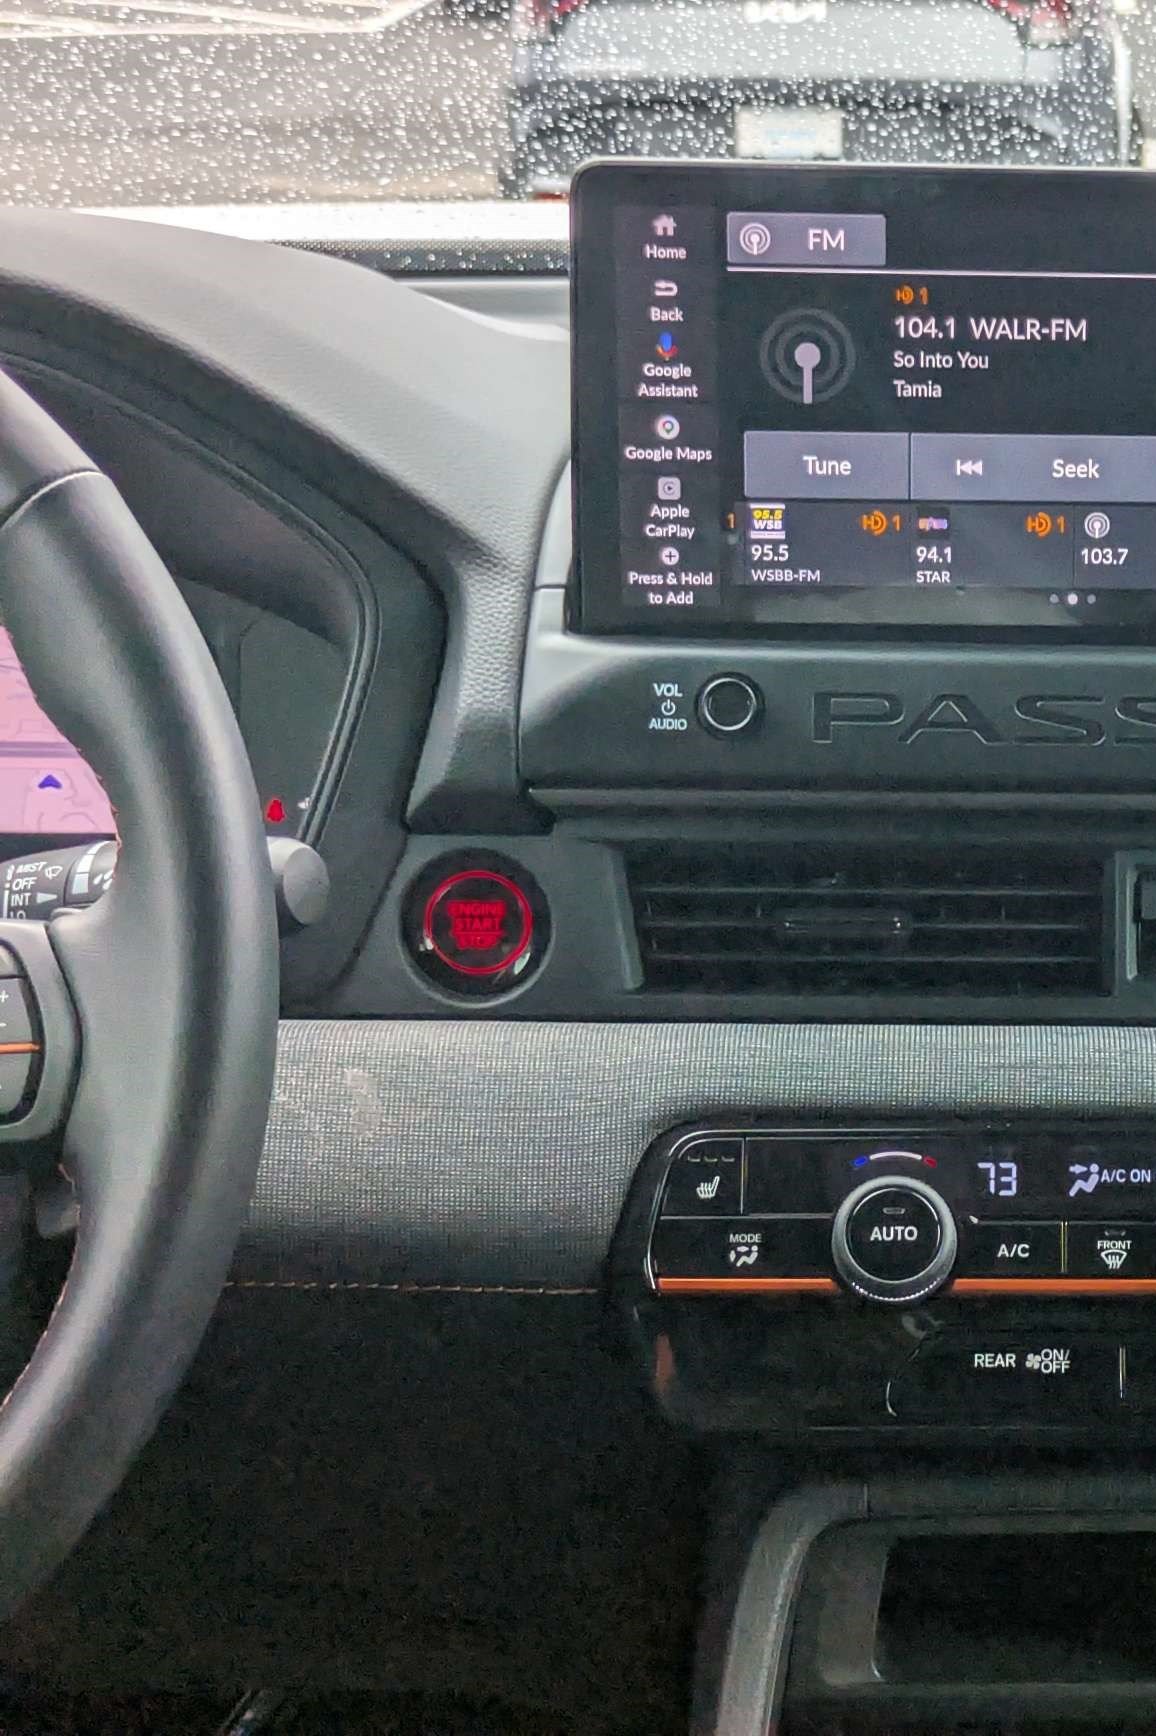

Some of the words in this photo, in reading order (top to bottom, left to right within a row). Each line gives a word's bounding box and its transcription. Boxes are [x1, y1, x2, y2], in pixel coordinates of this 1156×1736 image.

[808, 229, 845, 251] FM
[645, 244, 687, 260] Home
[650, 307, 684, 322] Back
[894, 316, 957, 339] 104.1
[970, 317, 1088, 341] WALR-FM
[893, 351, 915, 368] So
[920, 350, 953, 369] Into
[956, 352, 989, 370] You
[643, 364, 692, 379] Google
[638, 383, 699, 398] Assistant
[893, 380, 942, 399] Tamia
[625, 446, 674, 462] Google
[676, 447, 713, 463] Maps
[803, 456, 852, 476] Tune
[1052, 459, 1100, 479] Seek
[650, 504, 690, 520] Apple
[752, 509, 784, 520] 95.5
[753, 520, 783, 530] WSB
[892, 514, 901, 532] 1
[1056, 516, 1065, 534] 1
[645, 524, 696, 540] CarPlay
[751, 544, 789, 562] 95.5
[915, 546, 952, 563] 94.1
[1081, 547, 1129, 565] 103.7
[629, 571, 664, 586] Press
[666, 572, 677, 586] &
[679, 571, 713, 586] Hold
[751, 569, 821, 582] WSBB-FM
[916, 570, 951, 583] STAR
[649, 591, 663, 604] to
[666, 591, 694, 605] Add
[653, 683, 683, 698] VOL
[648, 717, 688, 731] AUDIO
[12, 877, 37, 891] OFF
[11, 893, 32, 906] INT
[454, 918, 500, 931] START
[977, 1162, 1017, 1196] 73
[1101, 1168, 1126, 1183] A/C
[1130, 1168, 1151, 1184] ON
[729, 1233, 762, 1243] MODE
[869, 1226, 918, 1241] AUTO
[997, 1243, 1030, 1258] A/C
[1097, 1240, 1132, 1250] FRONT
[974, 1353, 1016, 1368] REAR
[1041, 1349, 1070, 1361] ON/
[1041, 1360, 1070, 1374] OFF
